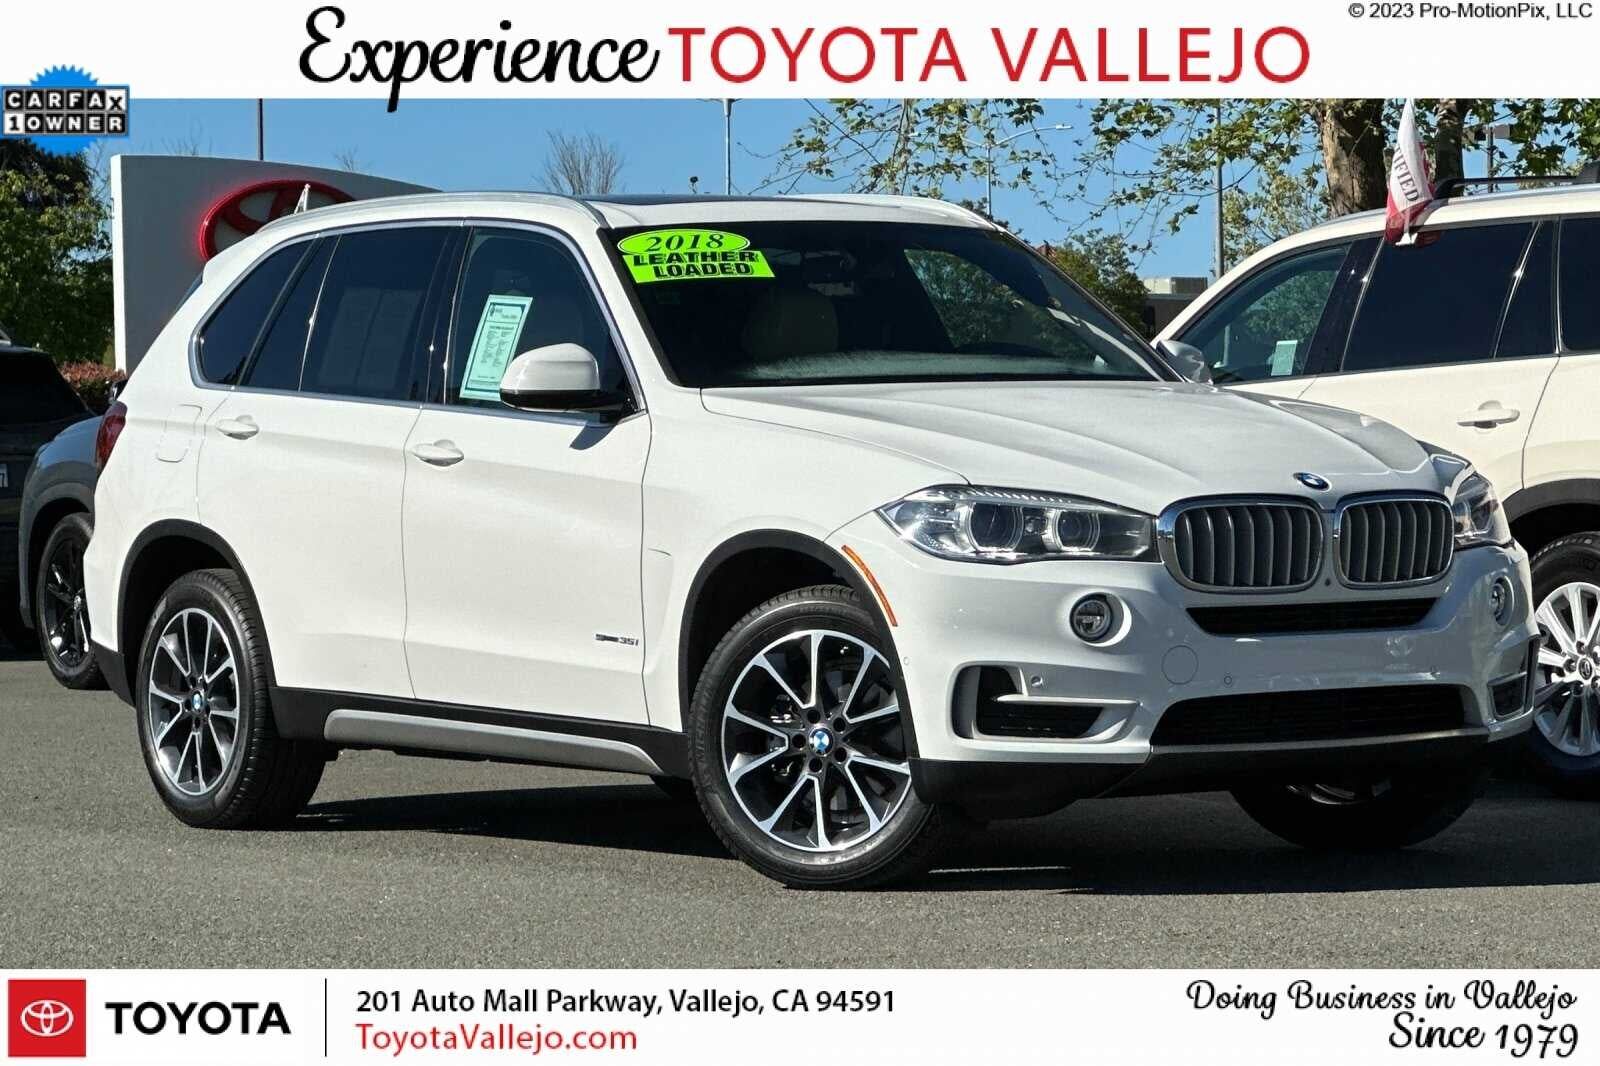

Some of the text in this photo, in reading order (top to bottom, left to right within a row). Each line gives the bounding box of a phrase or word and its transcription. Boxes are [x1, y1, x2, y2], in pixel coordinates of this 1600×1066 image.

[645, 234, 724, 252] 2018
[633, 251, 758, 267] LEATHER
[653, 262, 756, 279] LOADED
